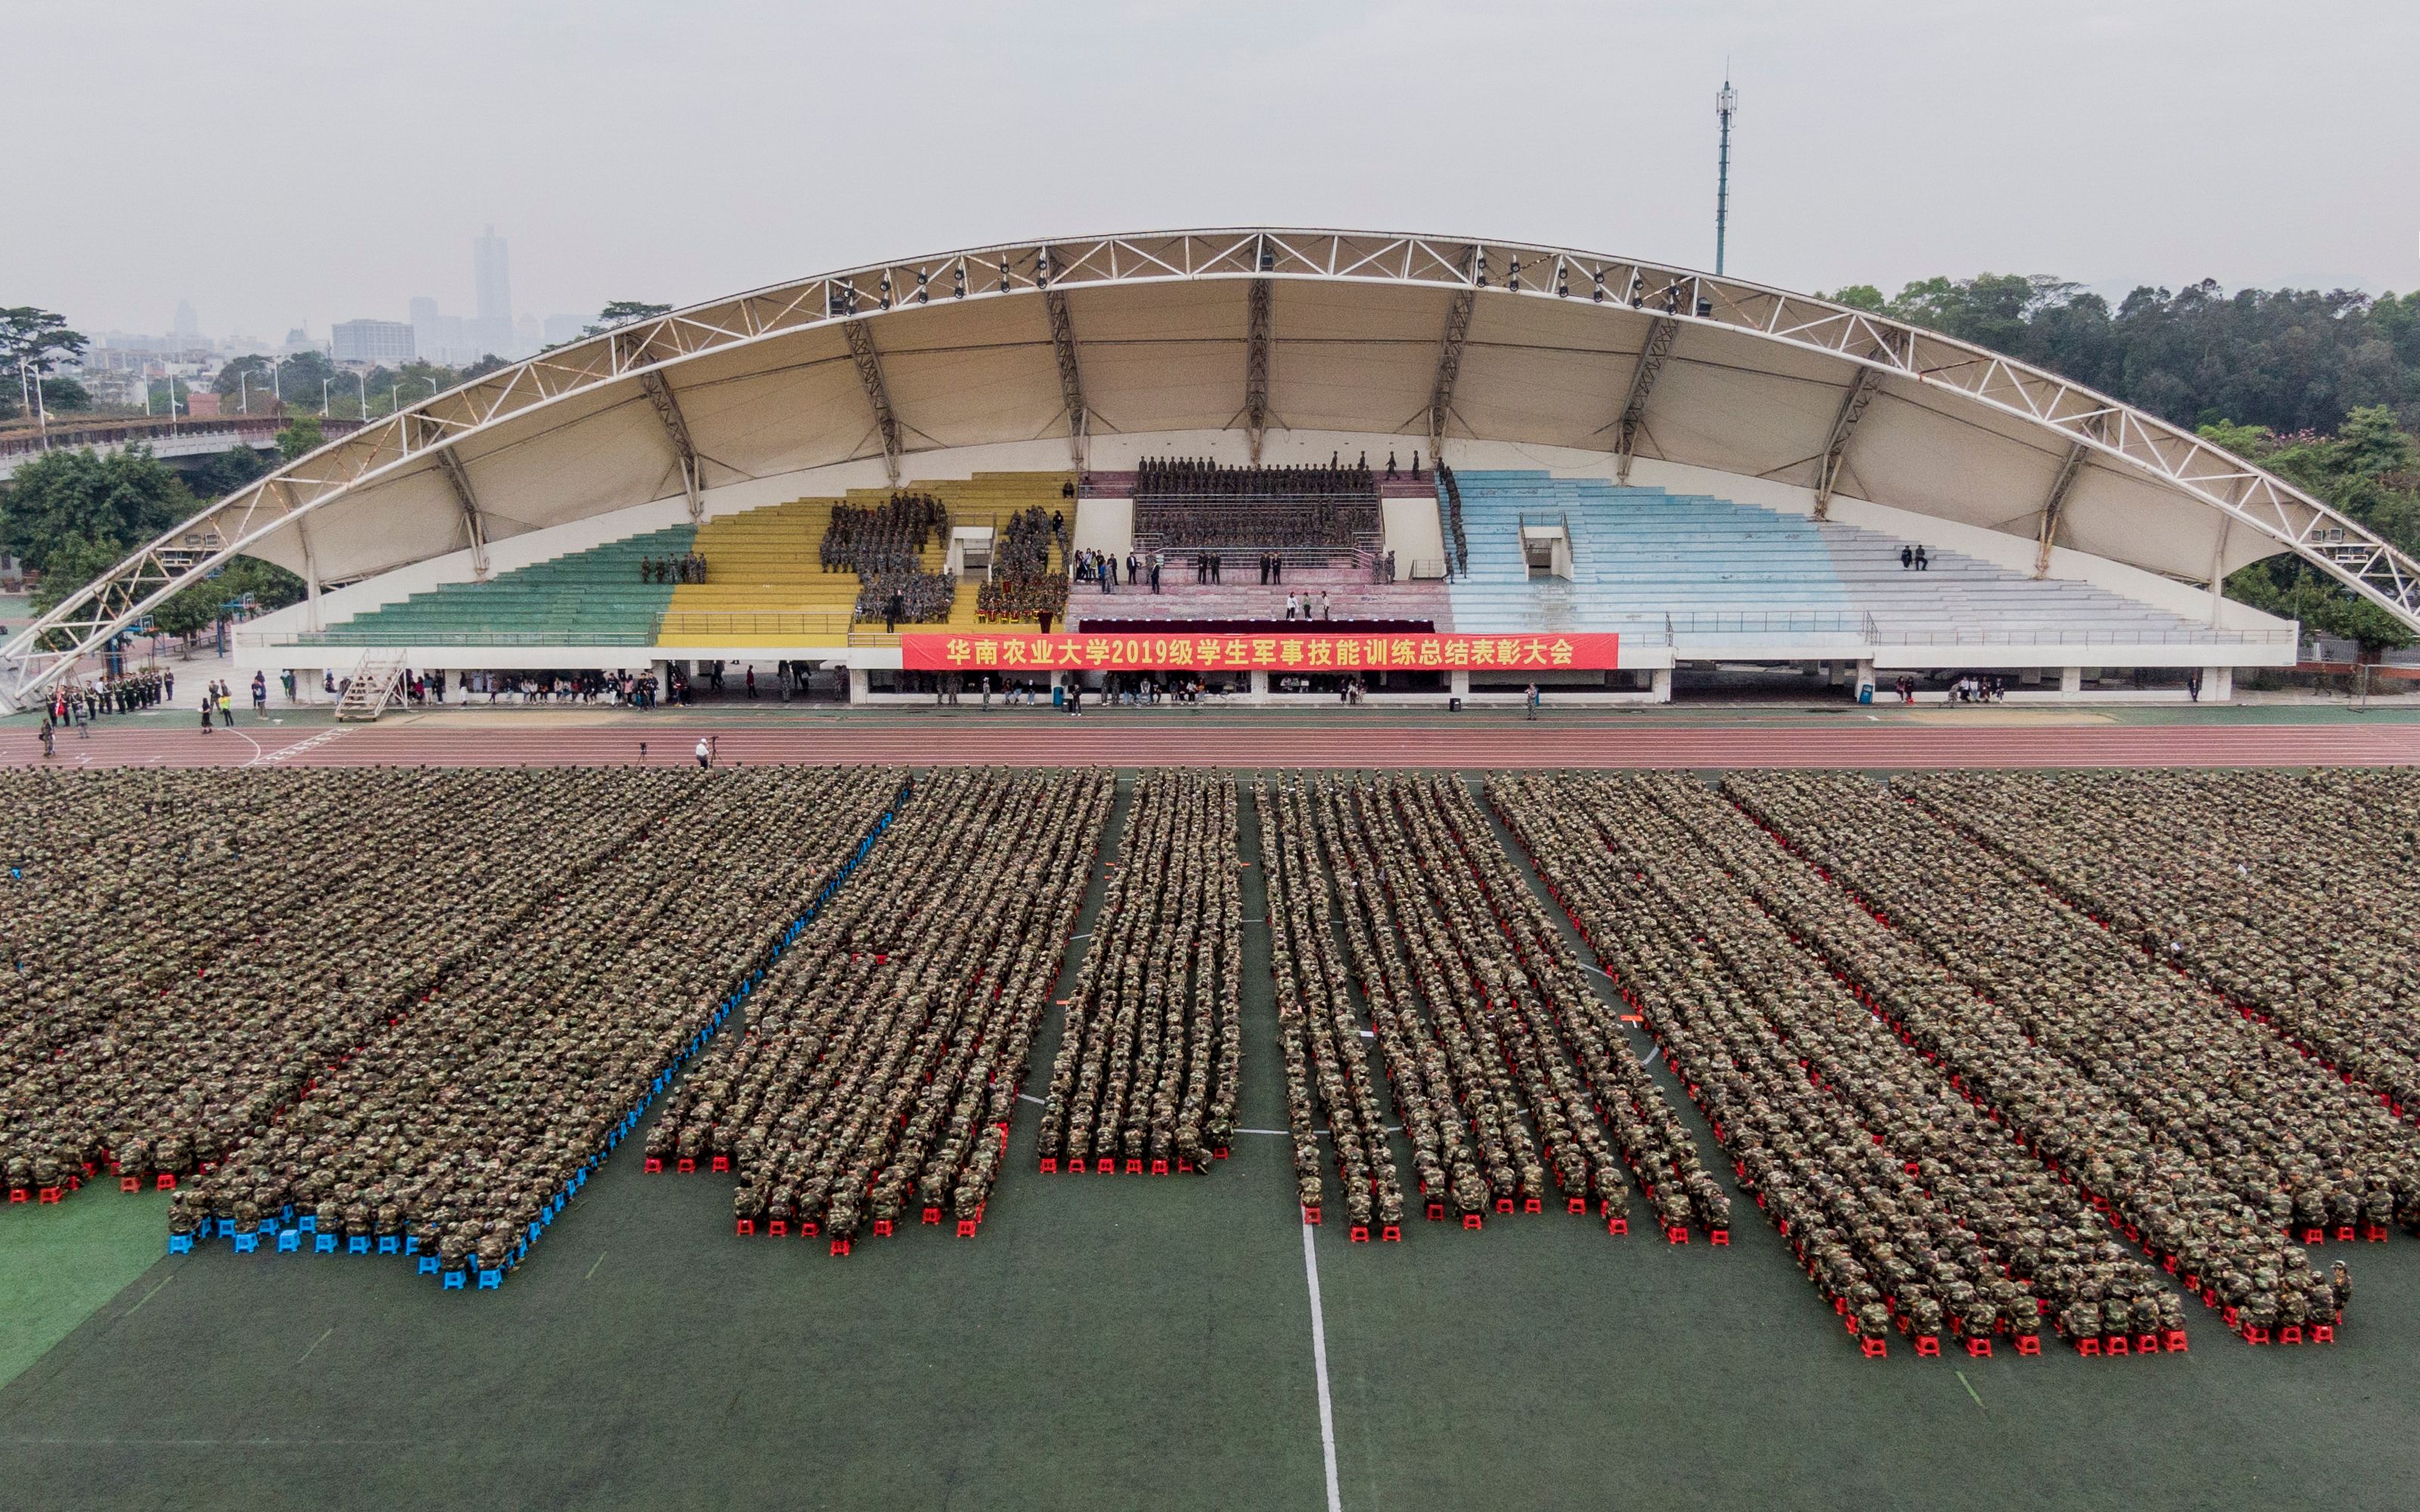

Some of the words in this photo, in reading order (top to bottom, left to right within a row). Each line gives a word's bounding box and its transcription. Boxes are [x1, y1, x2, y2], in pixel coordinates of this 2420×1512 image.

[947, 638, 1573, 666] 华南农业大学2019级学生军事技能训练总结表彰大会
